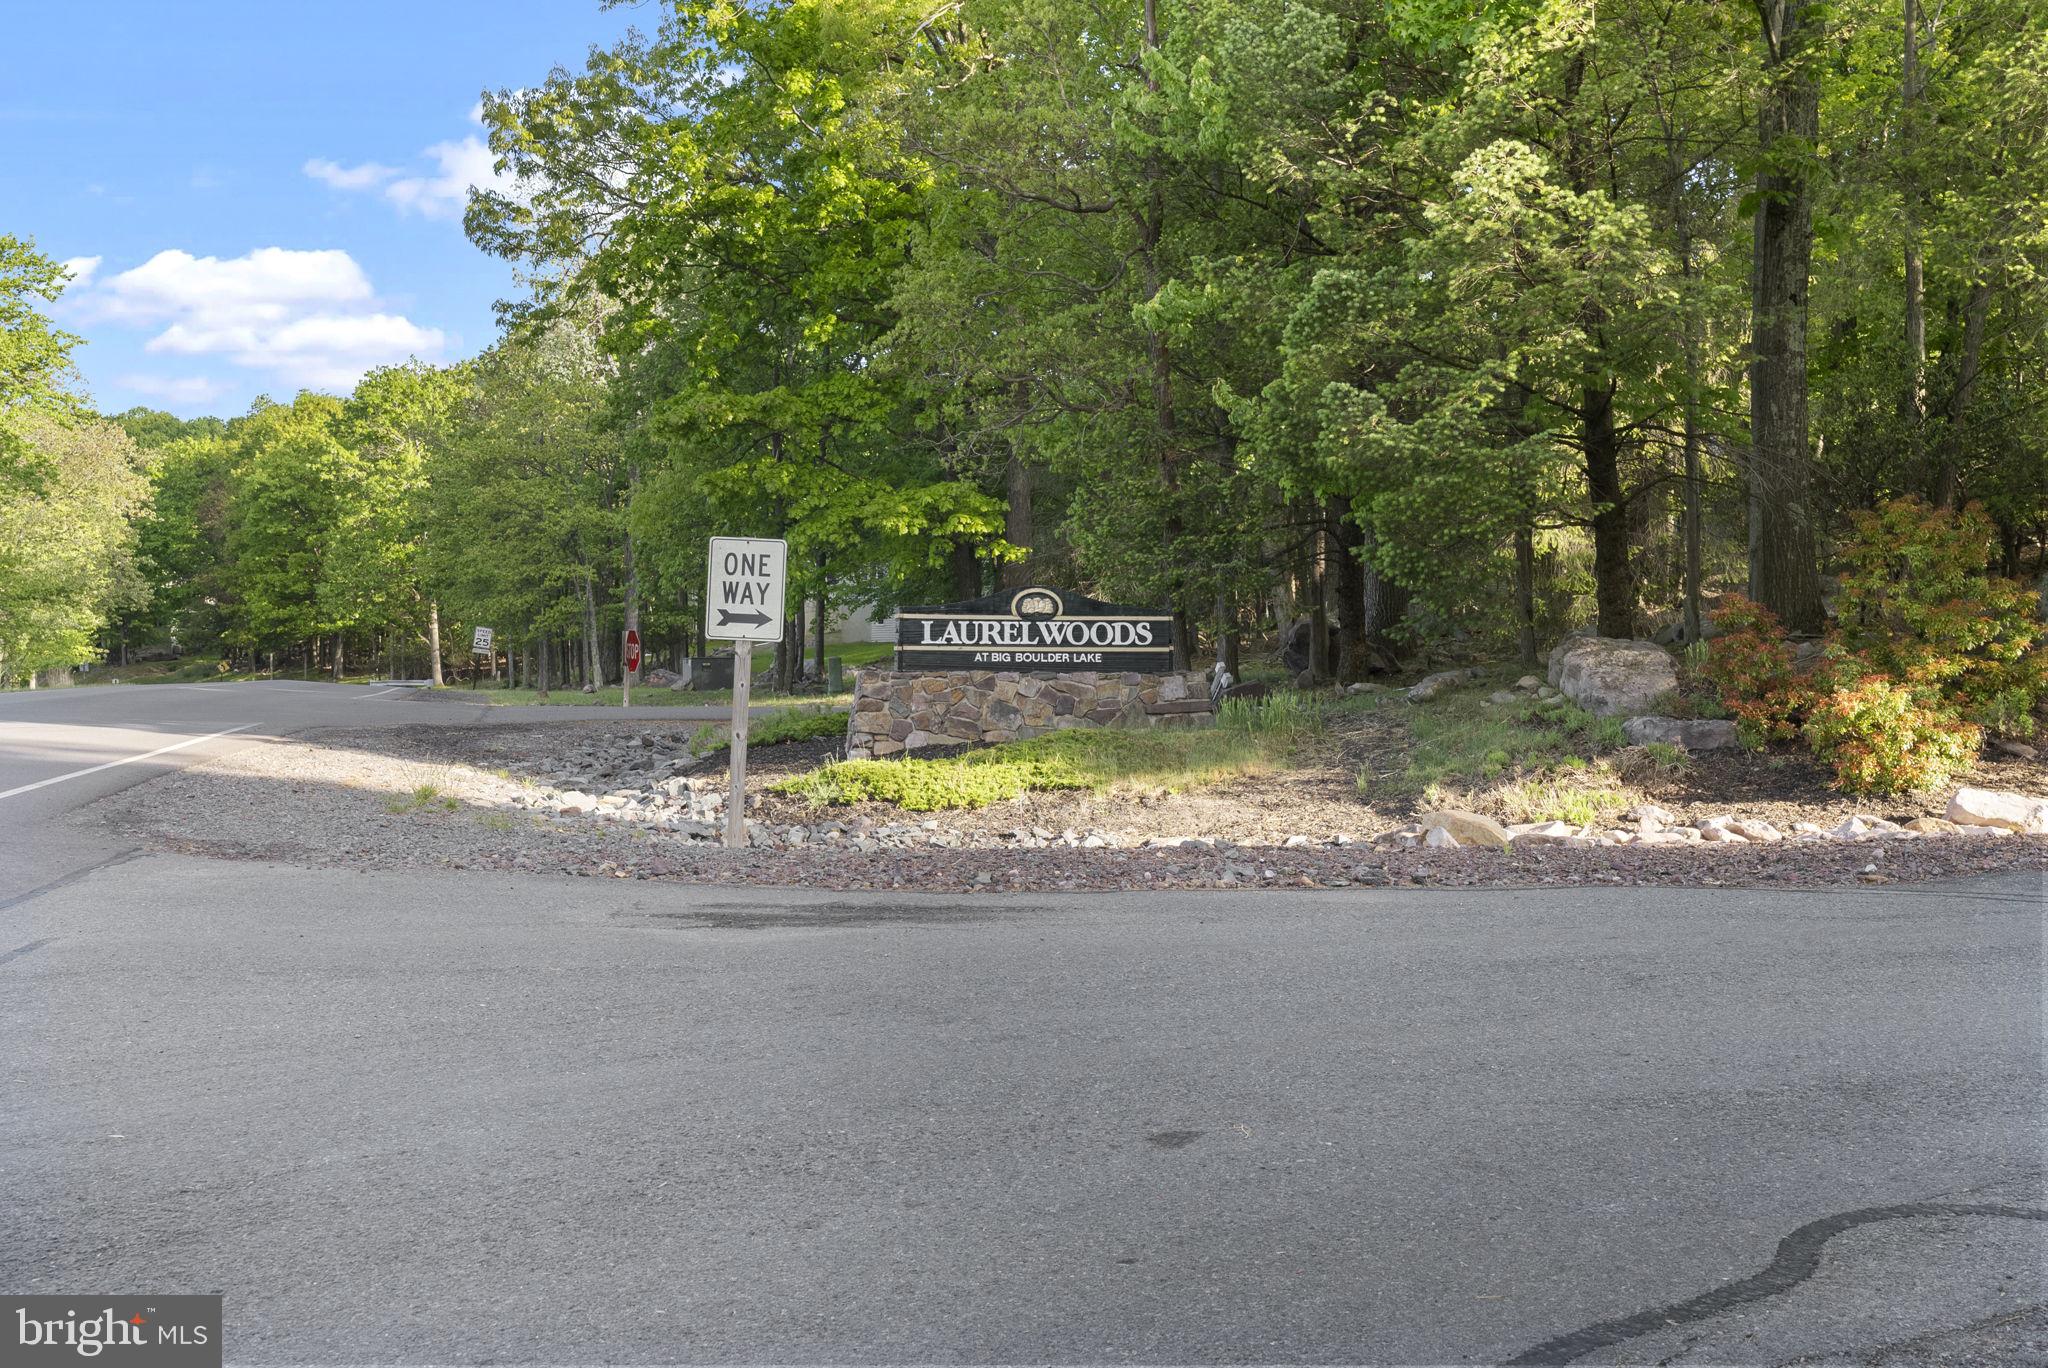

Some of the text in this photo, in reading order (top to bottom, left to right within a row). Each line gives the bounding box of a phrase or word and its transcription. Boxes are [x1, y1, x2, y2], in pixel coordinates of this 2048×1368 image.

[724, 552, 771, 577] ONE
[722, 581, 770, 605] WAY
[475, 637, 489, 646] 25
[921, 620, 1153, 646] LAURELWOODS
[626, 643, 639, 659] STOP
[974, 652, 1103, 663] AT BIG BOULDER LAKE
